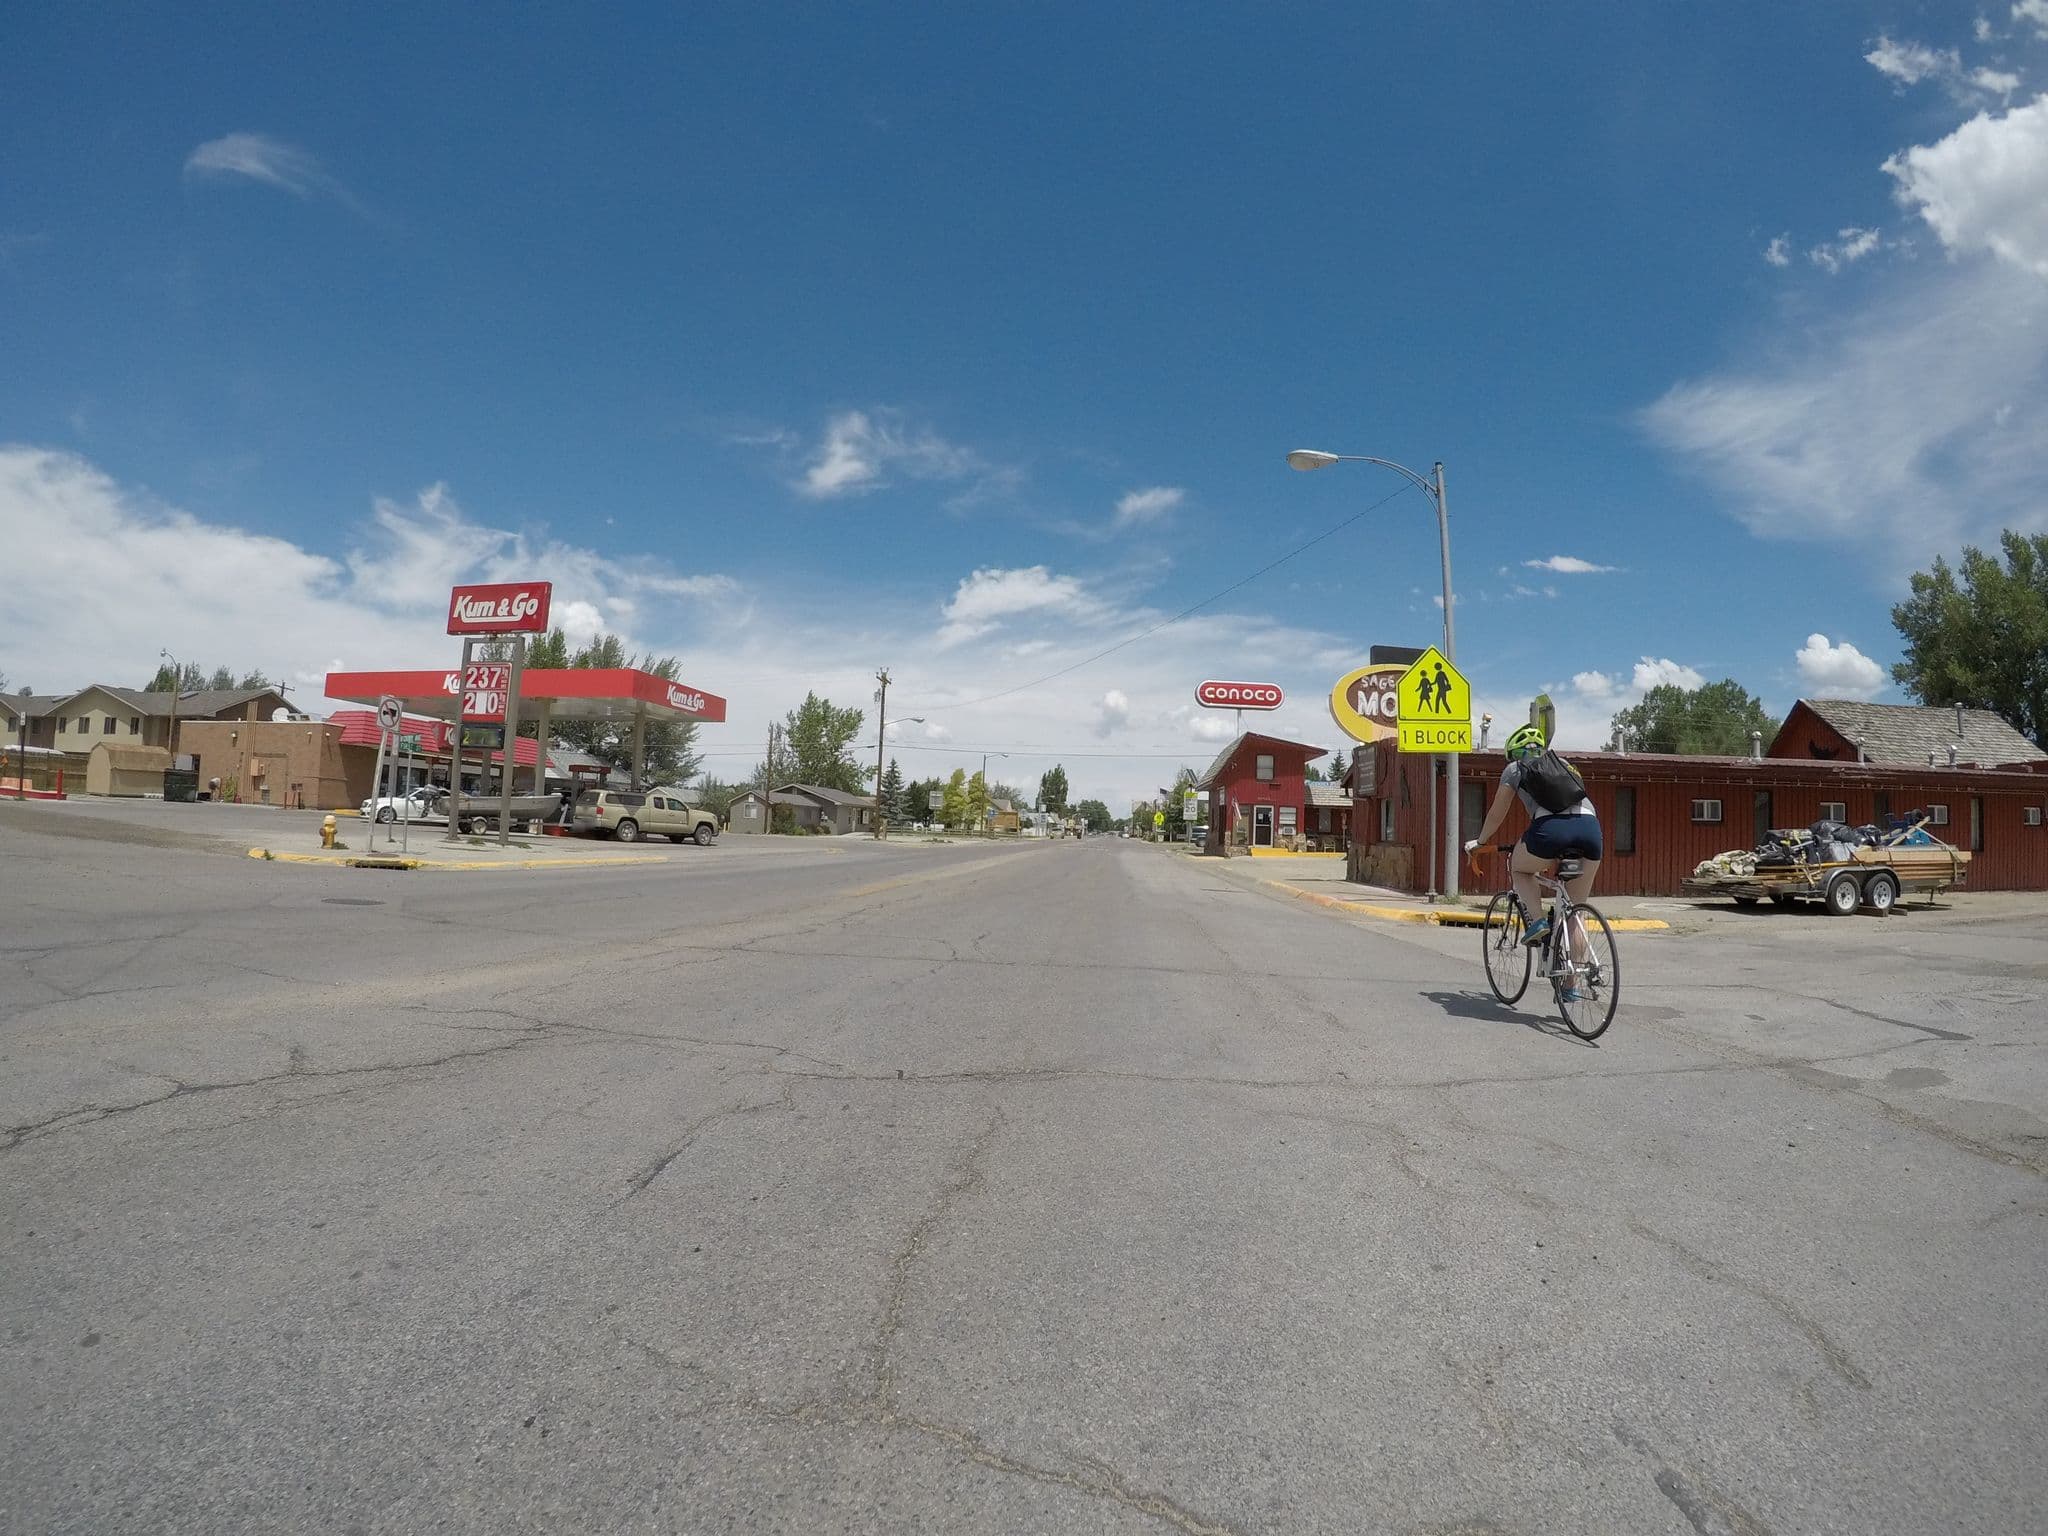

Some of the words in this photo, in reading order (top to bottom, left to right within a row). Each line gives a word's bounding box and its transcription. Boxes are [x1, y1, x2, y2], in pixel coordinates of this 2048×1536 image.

[453, 595, 495, 620] Kum
[497, 598, 510, 616] &
[512, 592, 539, 619] Go
[443, 674, 460, 693] Ku
[466, 667, 501, 689] 237
[463, 692, 498, 714] 20
[1357, 691, 1397, 718] MO
[1416, 730, 1467, 744] BLOCK
